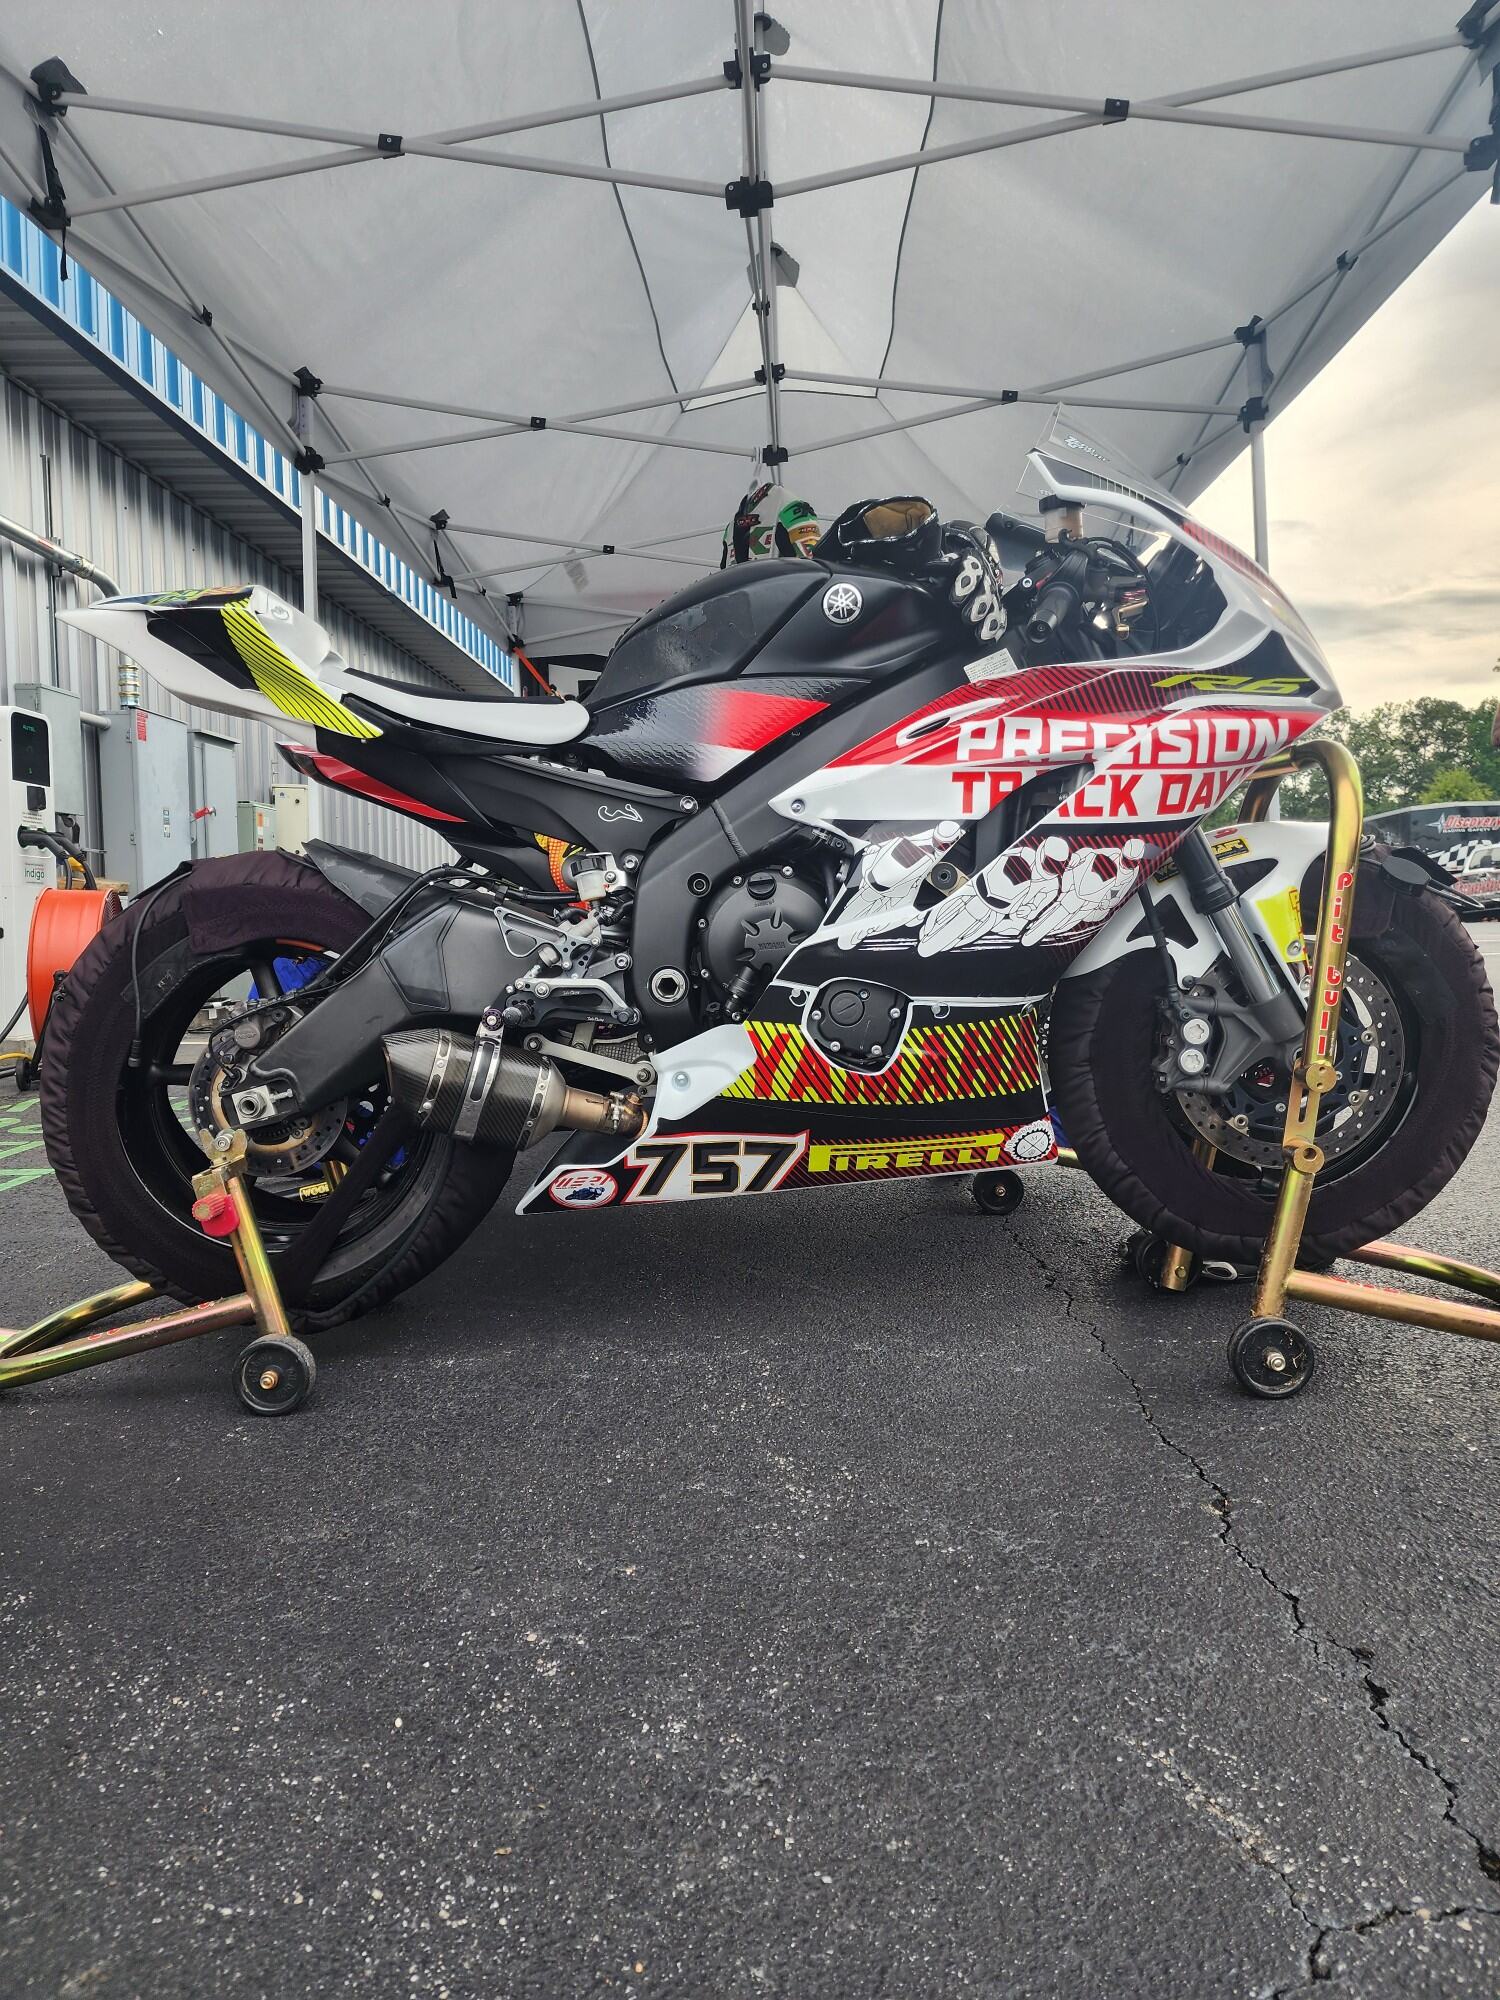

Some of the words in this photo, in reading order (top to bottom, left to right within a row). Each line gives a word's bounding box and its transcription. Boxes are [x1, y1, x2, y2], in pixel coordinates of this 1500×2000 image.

[1151, 674, 1311, 693] R6
[956, 716, 1290, 765] PRECISION
[951, 770, 1143, 818] TRCK
[633, 1138, 799, 1199] 757
[807, 1133, 1005, 1173] PIRELLI
